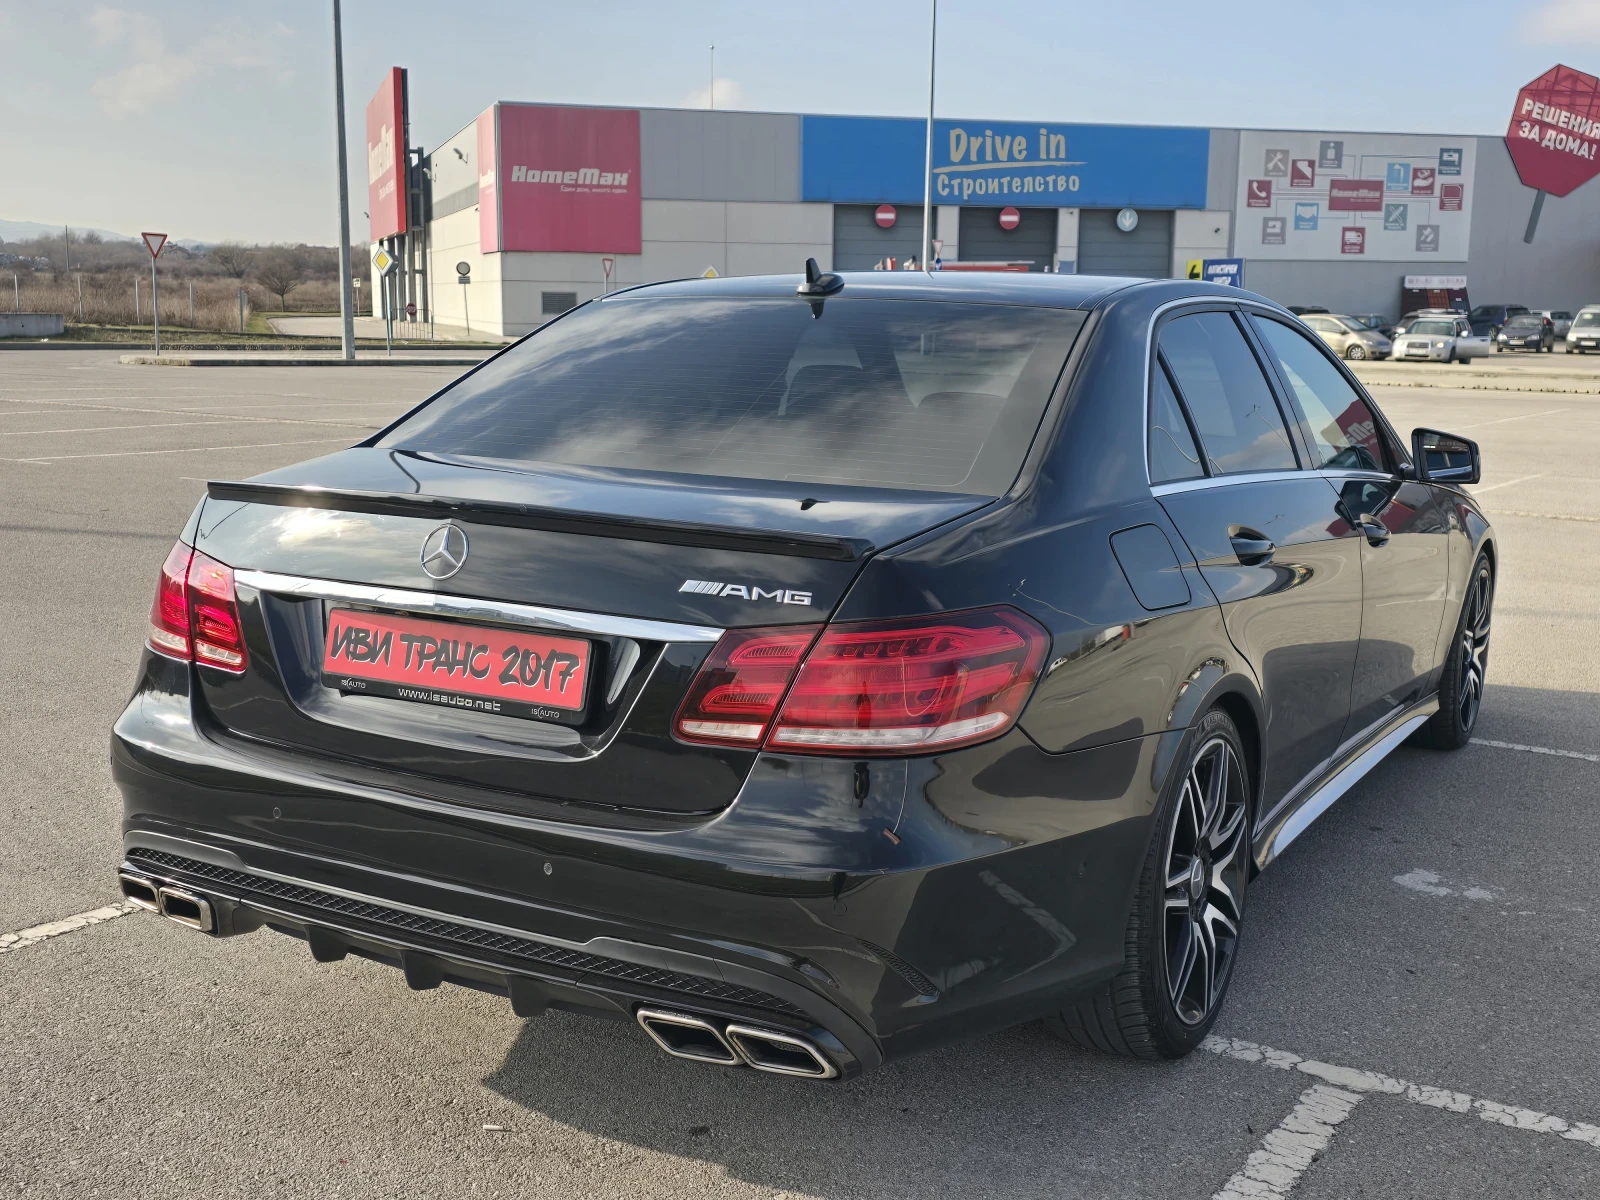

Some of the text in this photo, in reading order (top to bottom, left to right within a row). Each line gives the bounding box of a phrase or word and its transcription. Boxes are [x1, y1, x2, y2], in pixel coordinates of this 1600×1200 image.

[1521, 98, 1600, 140] РЕШЕНИЯ
[949, 127, 1066, 162] Drive in
[1518, 121, 1597, 160] ЗА ДОМА!
[511, 165, 629, 186] HomeMax
[937, 173, 1080, 200] Строителство
[719, 583, 813, 606] AMG
[330, 623, 581, 694] ИВИ ТРАНС 2017
[398, 687, 502, 712] www.isauto.net
